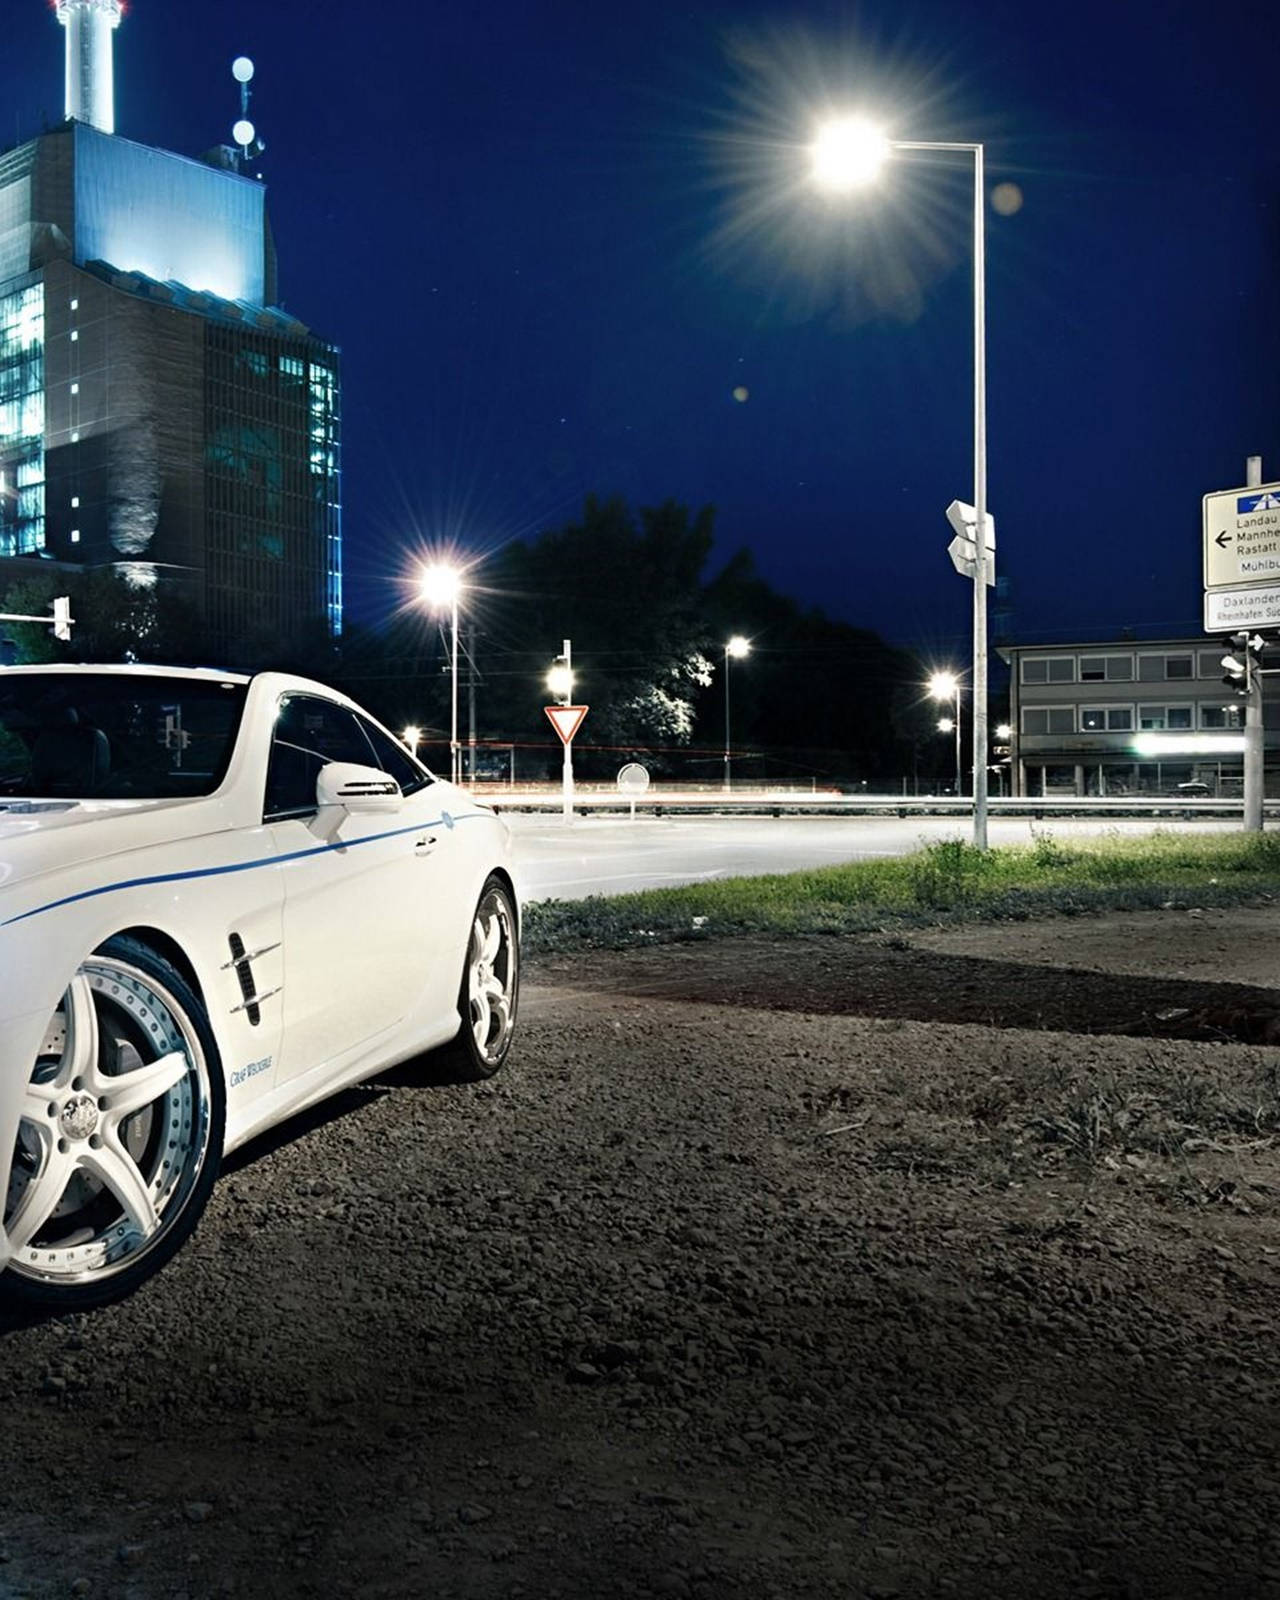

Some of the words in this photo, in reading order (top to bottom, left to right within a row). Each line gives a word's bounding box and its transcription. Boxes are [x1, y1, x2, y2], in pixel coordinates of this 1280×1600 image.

[1236, 516, 1277, 529] Landau
[1236, 529, 1280, 541] Mannhe
[1236, 542, 1277, 556] Rastatt
